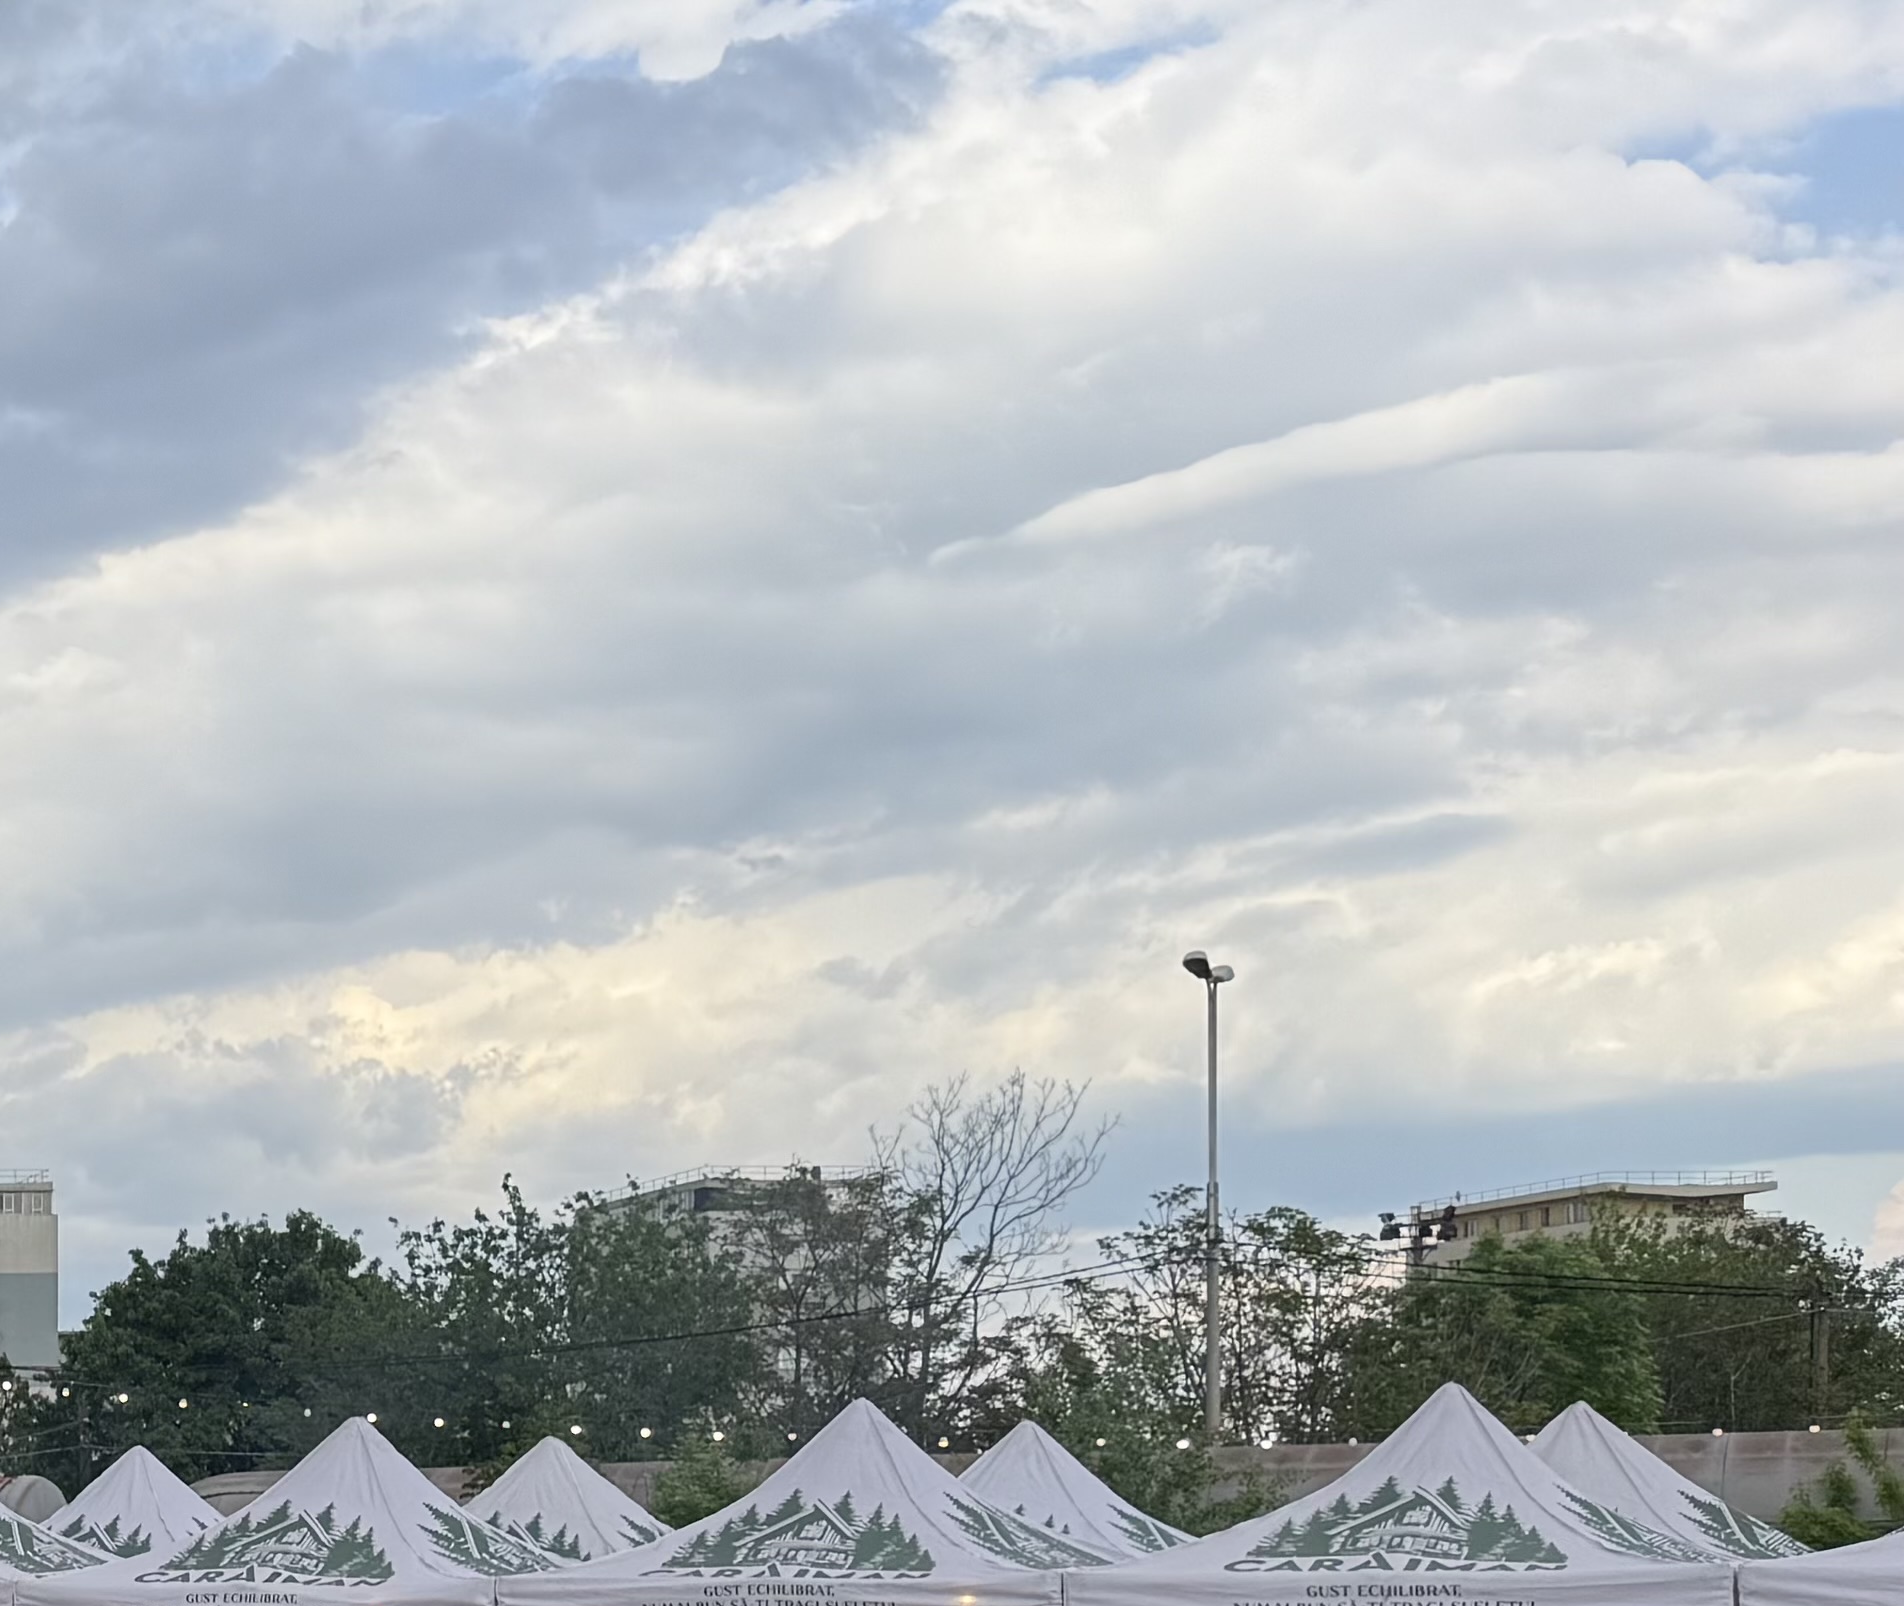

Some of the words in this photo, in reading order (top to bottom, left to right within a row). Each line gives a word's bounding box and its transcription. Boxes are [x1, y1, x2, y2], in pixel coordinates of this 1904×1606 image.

[186, 1593, 217, 1603] GUST
[703, 1584, 742, 1598] GUST
[1306, 1584, 1351, 1598] GUST
